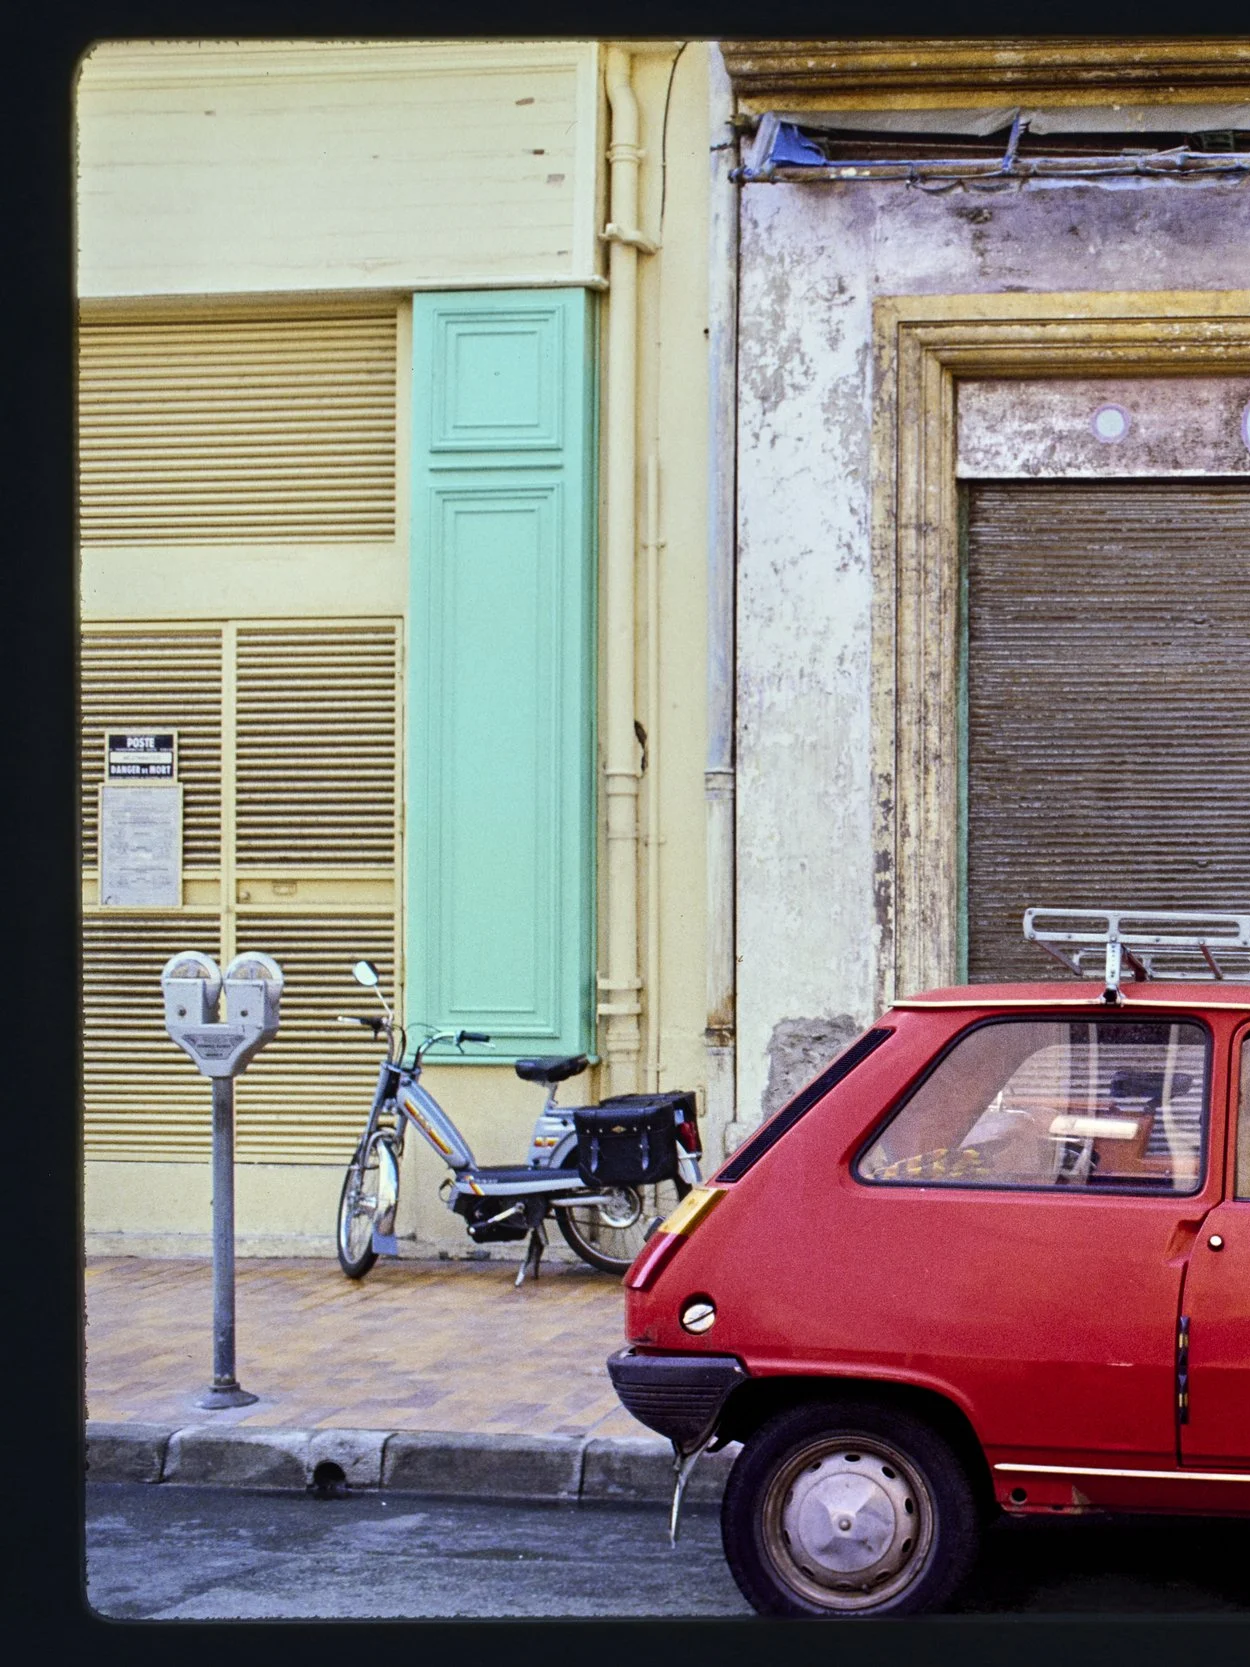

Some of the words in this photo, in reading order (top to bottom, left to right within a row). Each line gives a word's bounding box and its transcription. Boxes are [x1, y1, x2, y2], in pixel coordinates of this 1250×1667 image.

[126, 737, 155, 748] POSTE
[110, 765, 140, 774] DANGER
[149, 765, 171, 774] MORT
